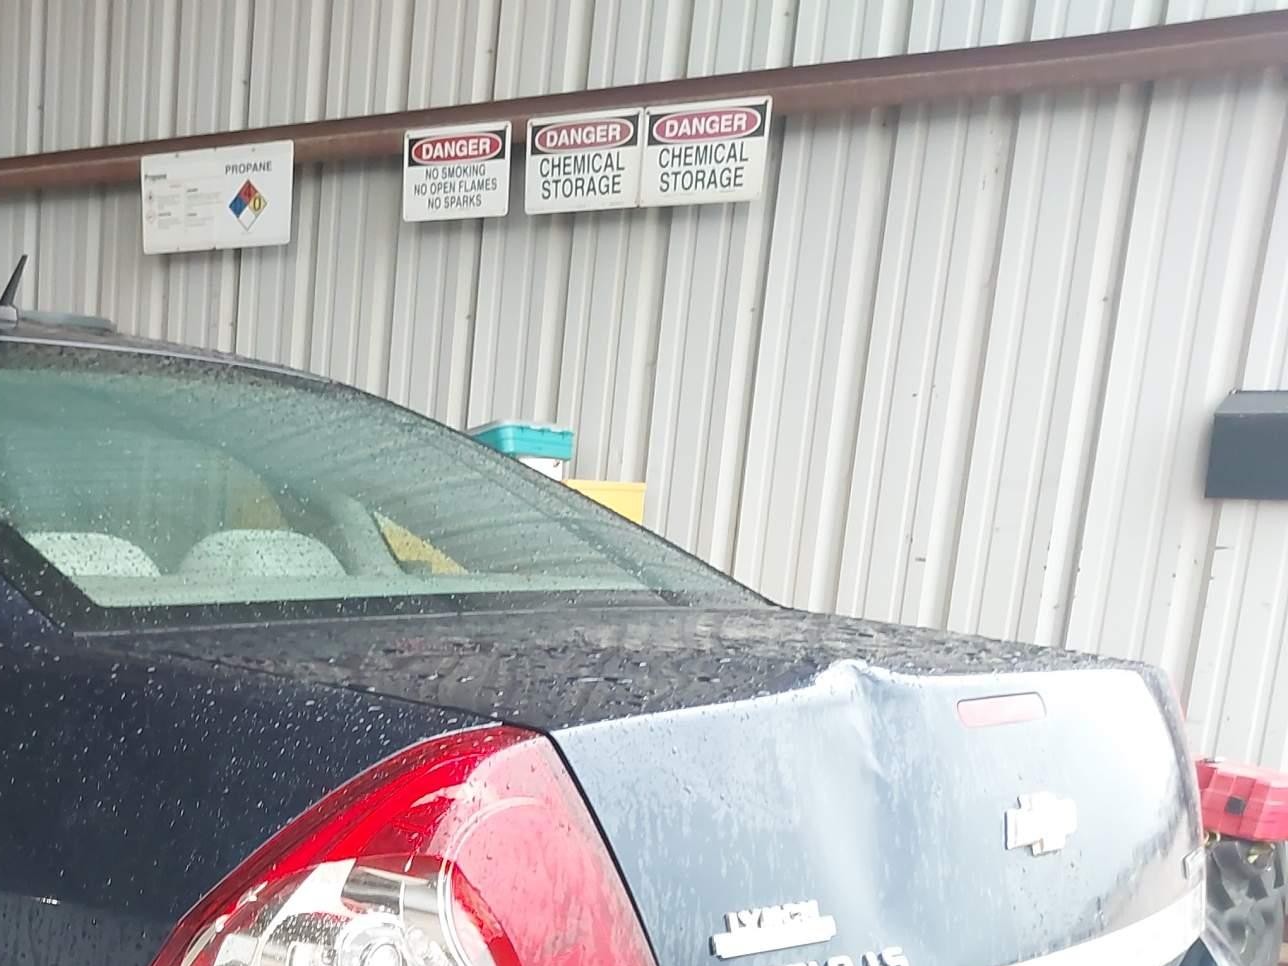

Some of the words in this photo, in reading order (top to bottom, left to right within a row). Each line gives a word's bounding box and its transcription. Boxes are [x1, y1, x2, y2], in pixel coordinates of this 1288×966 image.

[546, 124, 621, 148] DANGER
[665, 112, 747, 138] DANGER
[422, 138, 491, 160] DANGER
[658, 141, 749, 169] CHEMICAL
[225, 160, 272, 174] PROPANE
[425, 167, 439, 180] NO
[441, 164, 486, 179] SMOKING
[540, 151, 625, 178] CHEMICAL
[414, 183, 427, 196] NO
[430, 181, 455, 195] OPEN
[458, 178, 497, 193] FLAMES
[541, 174, 621, 200] STORAGE
[659, 166, 744, 193] STORAGE
[428, 197, 441, 210] NO
[444, 194, 482, 209] SPARKS
